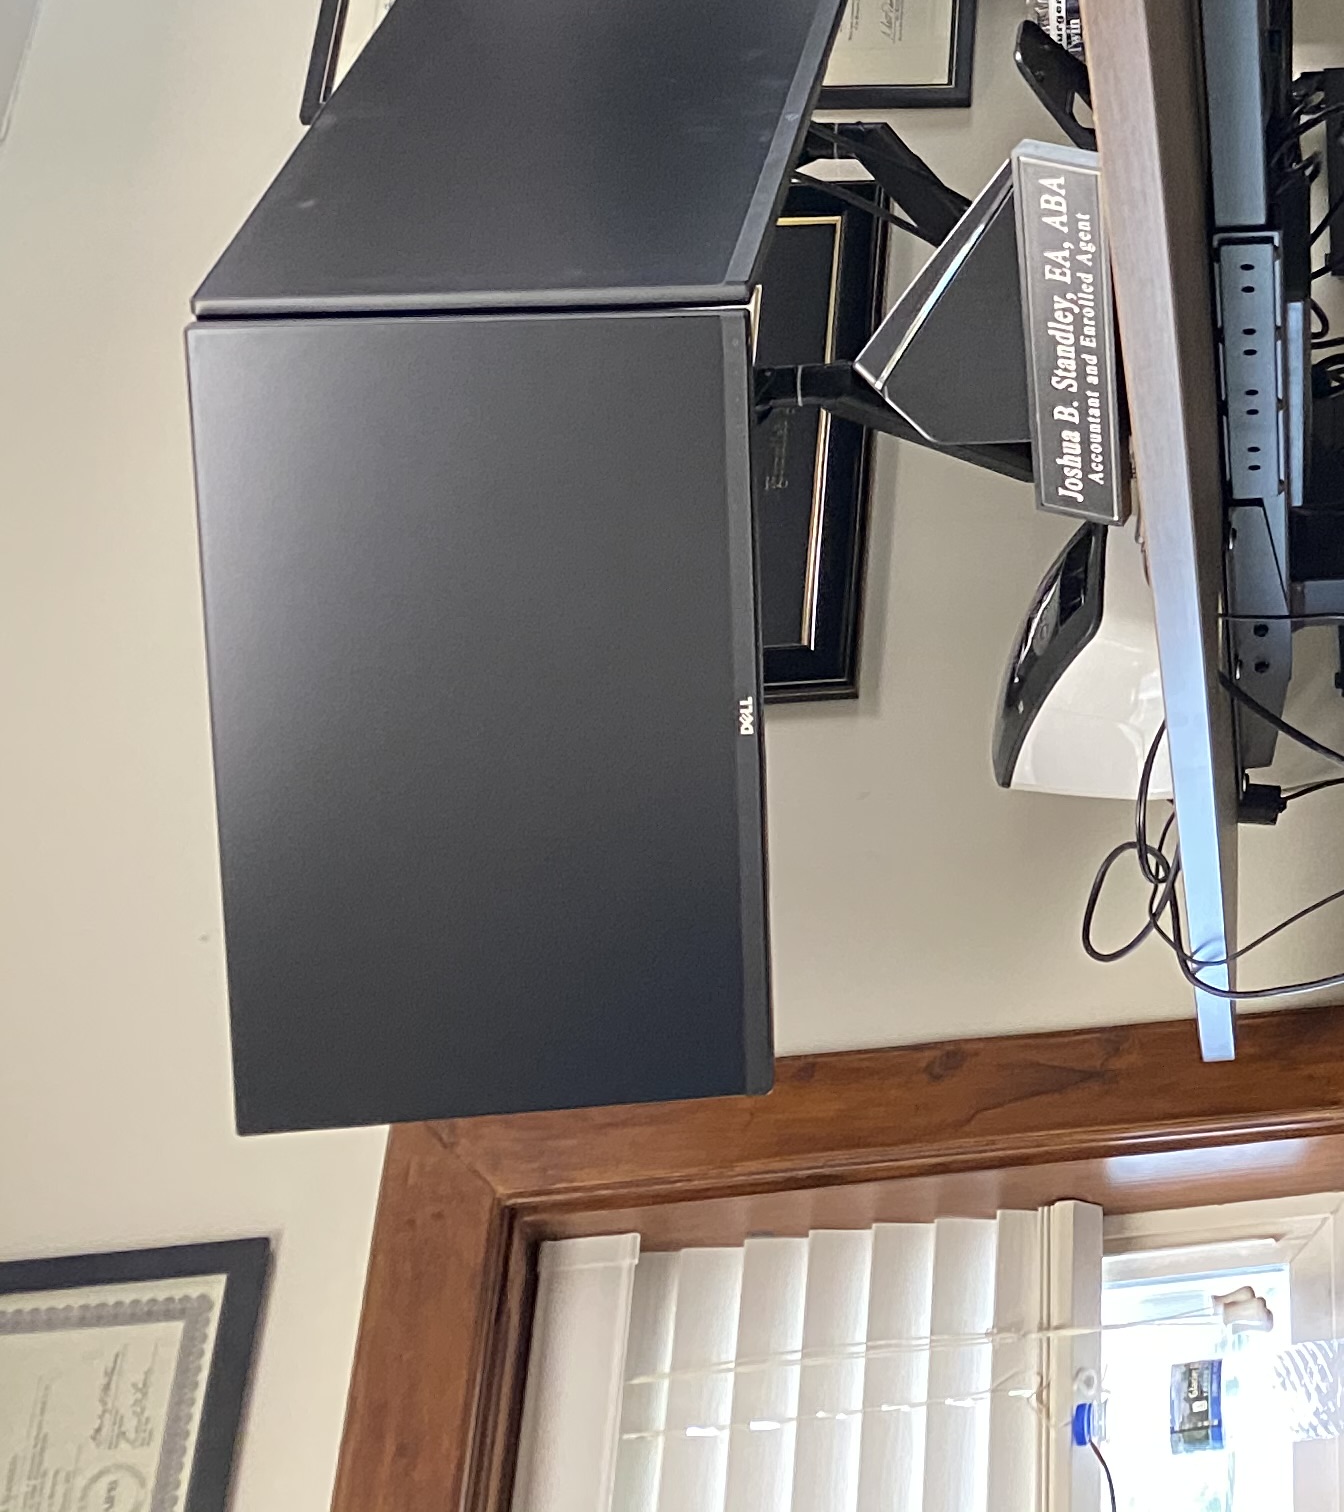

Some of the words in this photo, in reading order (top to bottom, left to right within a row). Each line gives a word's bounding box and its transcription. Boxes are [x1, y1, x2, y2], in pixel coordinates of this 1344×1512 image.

[1038, 176, 1068, 234] ABA
[1043, 241, 1075, 285] EA,
[1075, 212, 1096, 267] Agent
[1076, 272, 1096, 348] Enrolled
[1047, 292, 1081, 393] Standley,
[1081, 353, 1099, 385] and
[1053, 401, 1079, 425] B.
[1086, 390, 1104, 485] Accountant
[1056, 429, 1084, 503] Joshua
[739, 696, 754, 735] DELL
